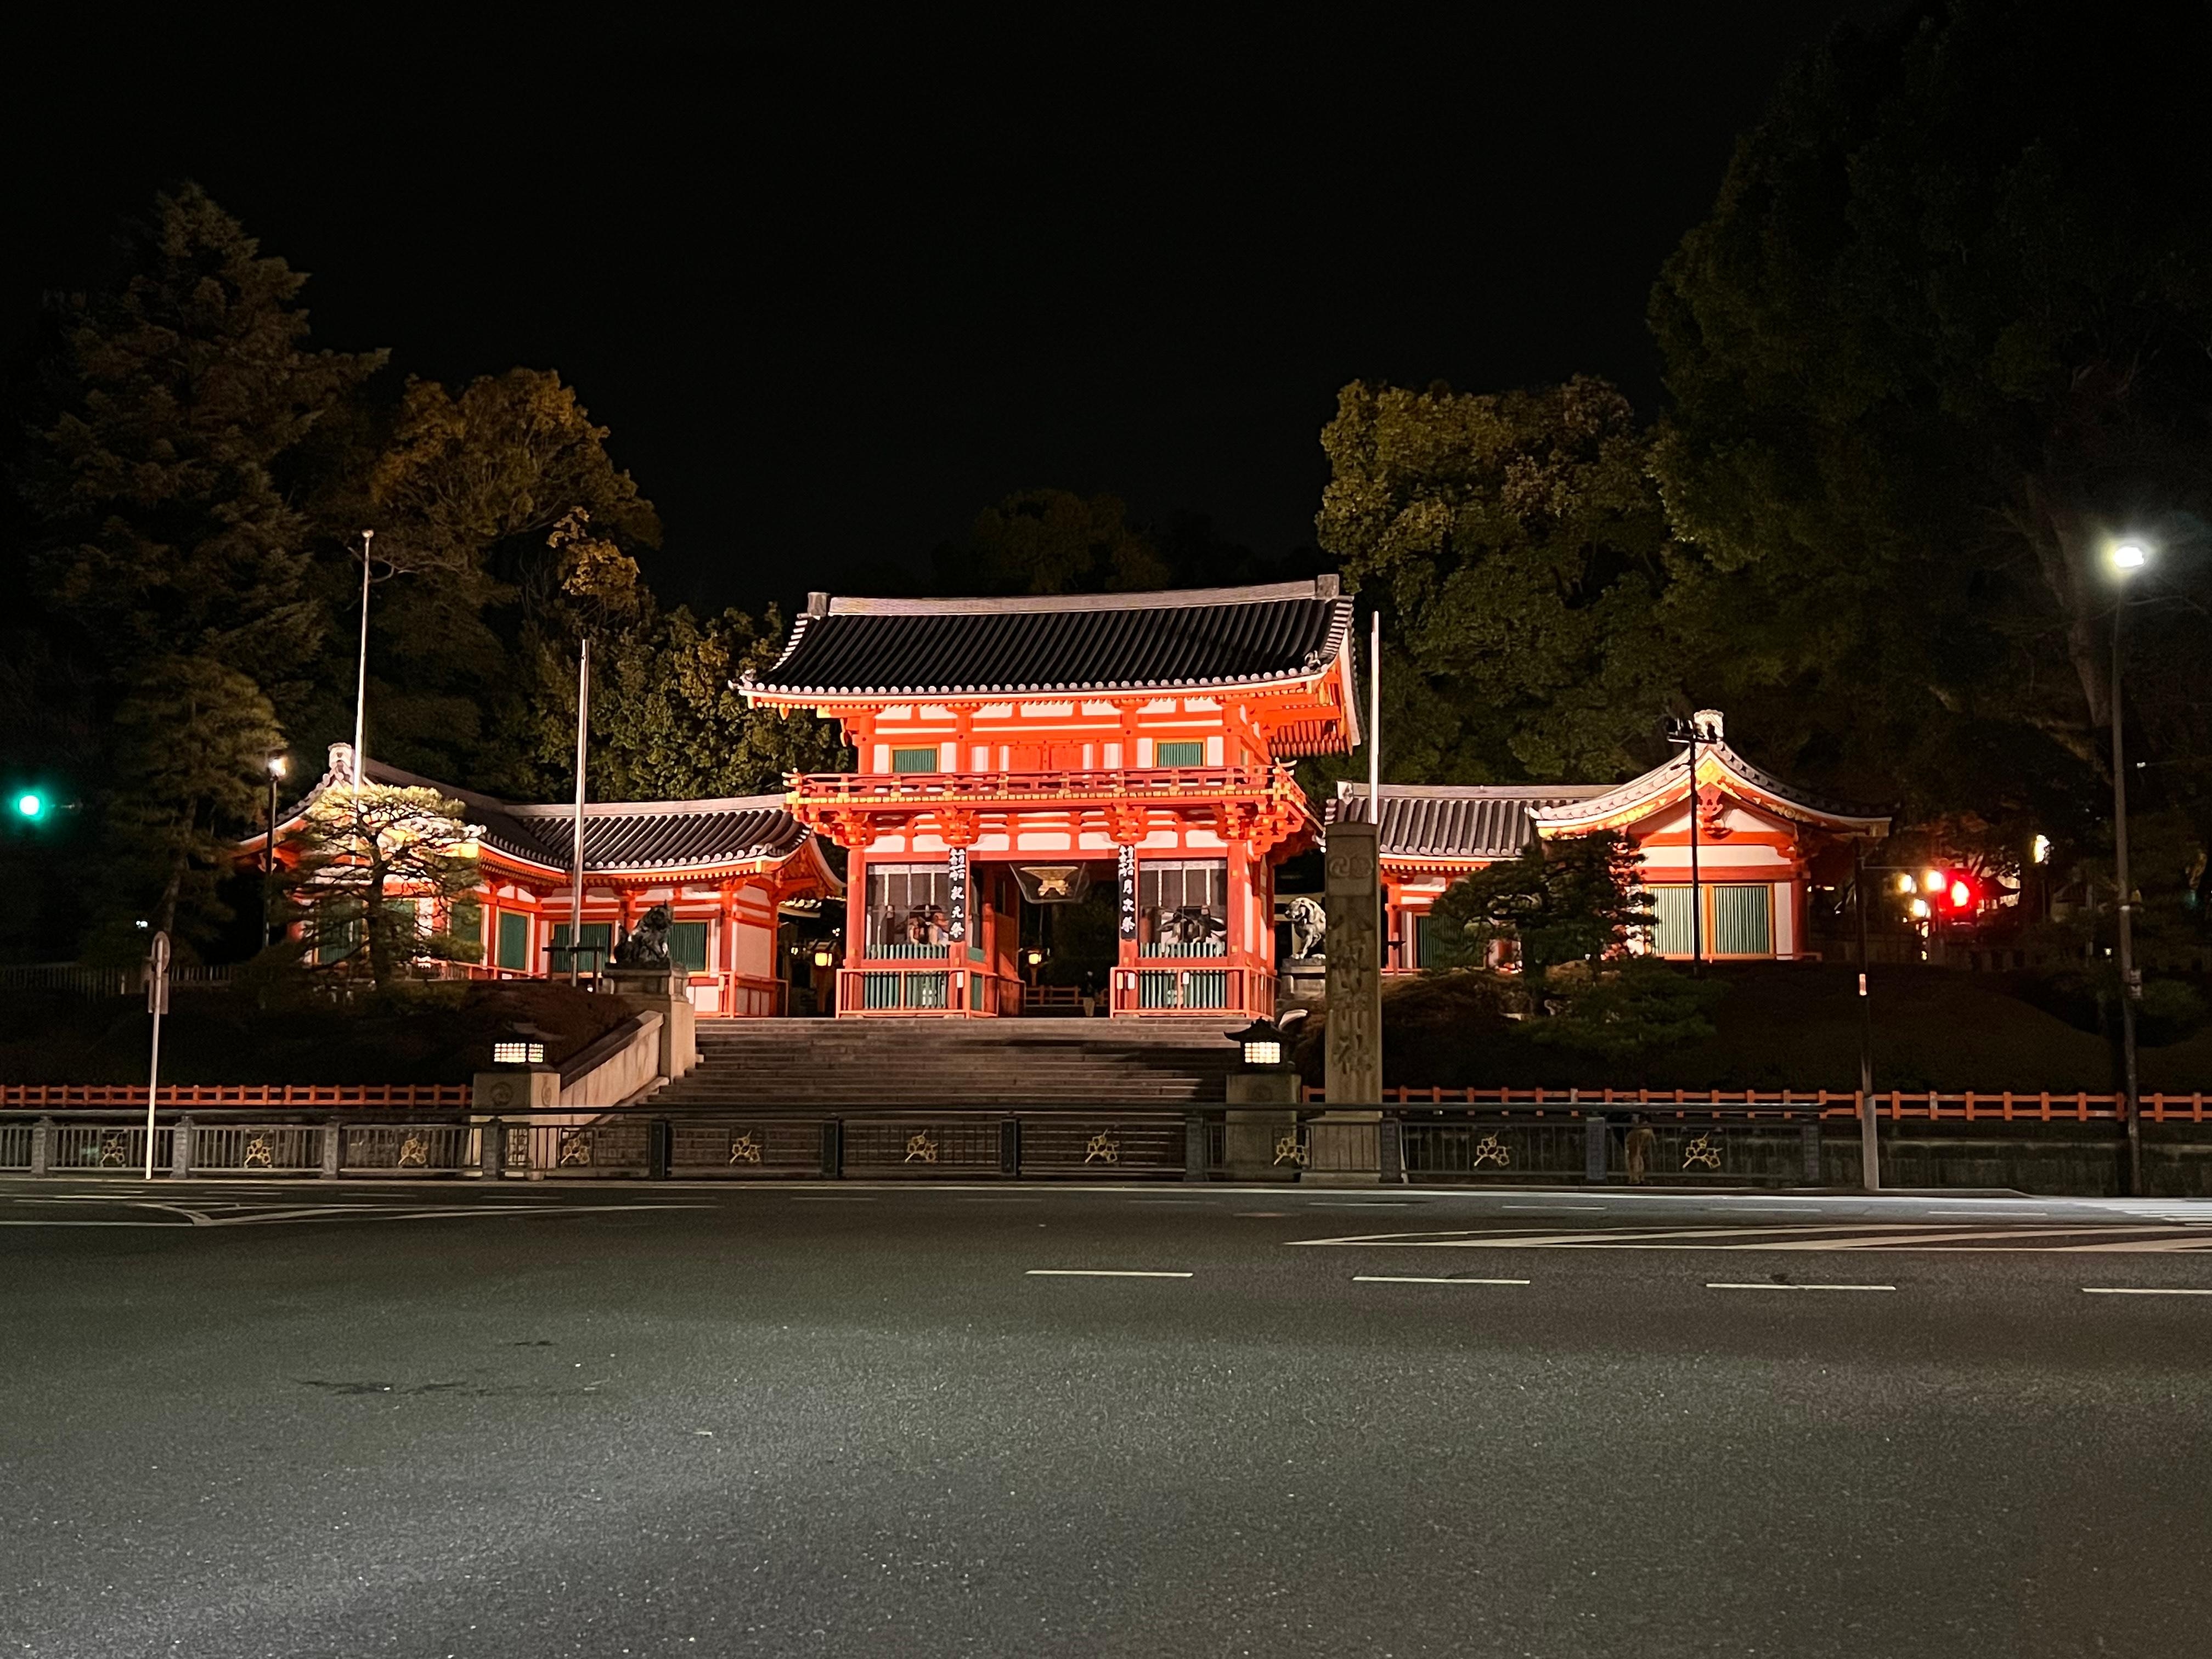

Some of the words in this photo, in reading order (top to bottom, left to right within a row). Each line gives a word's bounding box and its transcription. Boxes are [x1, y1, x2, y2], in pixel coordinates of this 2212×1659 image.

[1121, 879, 1136, 932] 月次祭
[1328, 912, 1374, 1074] 八坂神社
